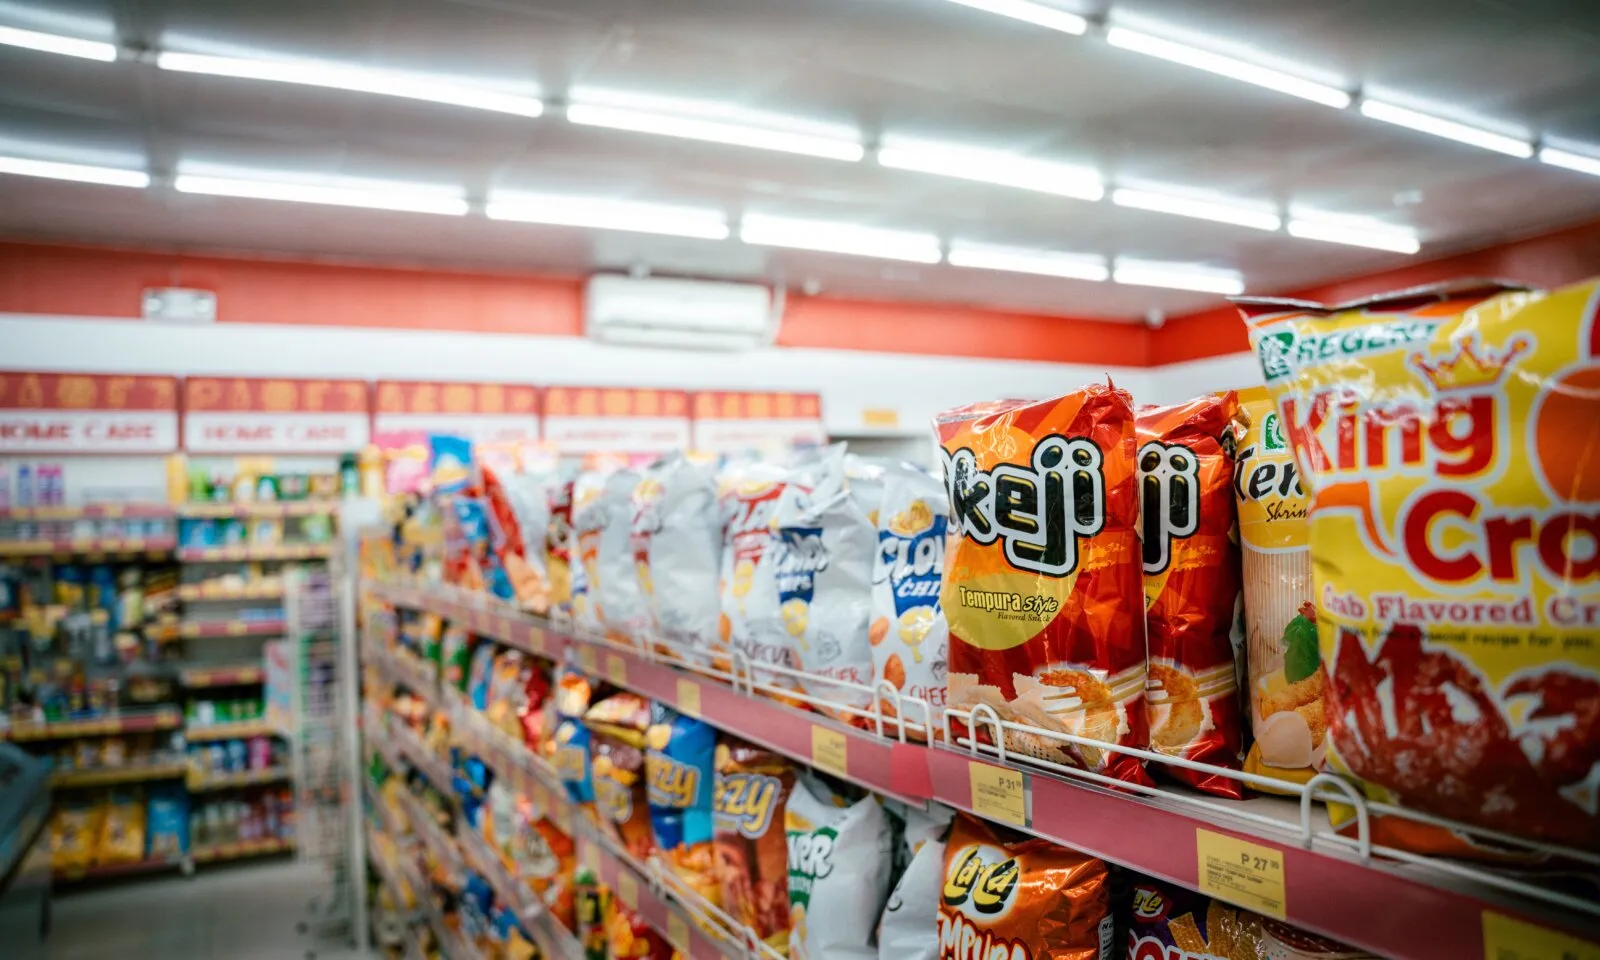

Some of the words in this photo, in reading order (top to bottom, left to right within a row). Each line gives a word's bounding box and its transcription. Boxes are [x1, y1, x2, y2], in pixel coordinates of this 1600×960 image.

[1281, 389, 1494, 476] King
[960, 586, 1022, 612] Tempura
[1023, 595, 1058, 616] Style
[1376, 595, 1533, 623] Flavored
[997, 611, 1026, 621] Flavored
[1006, 778, 1015, 790] 31
[1241, 852, 1250, 865] P
[1253, 856, 1269, 871] 27
